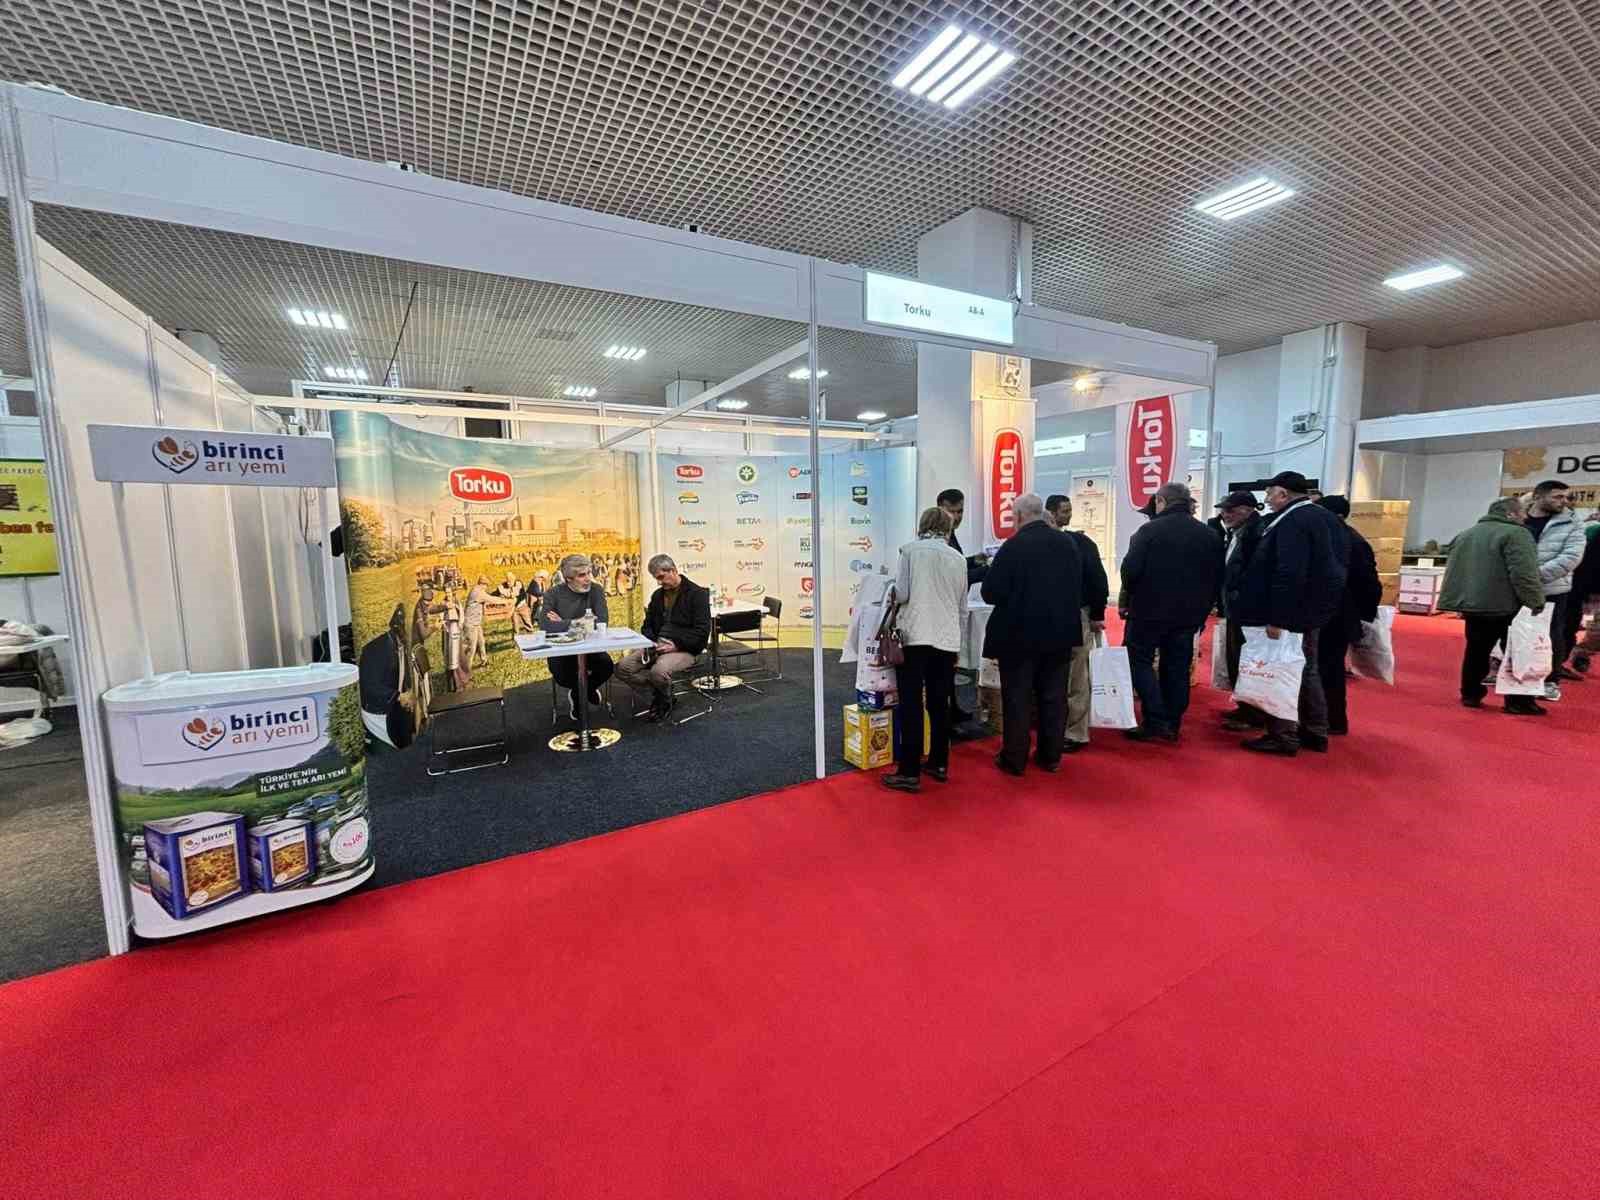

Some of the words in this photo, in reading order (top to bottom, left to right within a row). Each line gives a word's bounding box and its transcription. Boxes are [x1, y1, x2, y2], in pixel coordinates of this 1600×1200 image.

[904, 303, 932, 317] Torku
[202, 441, 284, 460] birinci
[205, 461, 231, 473] arı
[454, 472, 505, 494] Torku
[1000, 442, 1019, 529] Torku
[230, 706, 309, 731] birinci
[232, 731, 257, 744] arı
[259, 767, 318, 785] TÜRKİYE'NİN
[260, 783, 277, 793] İLK
[278, 781, 290, 789] VE
[292, 777, 310, 786] TEK
[310, 775, 326, 783] ARI
[327, 768, 347, 779] YEMİ
